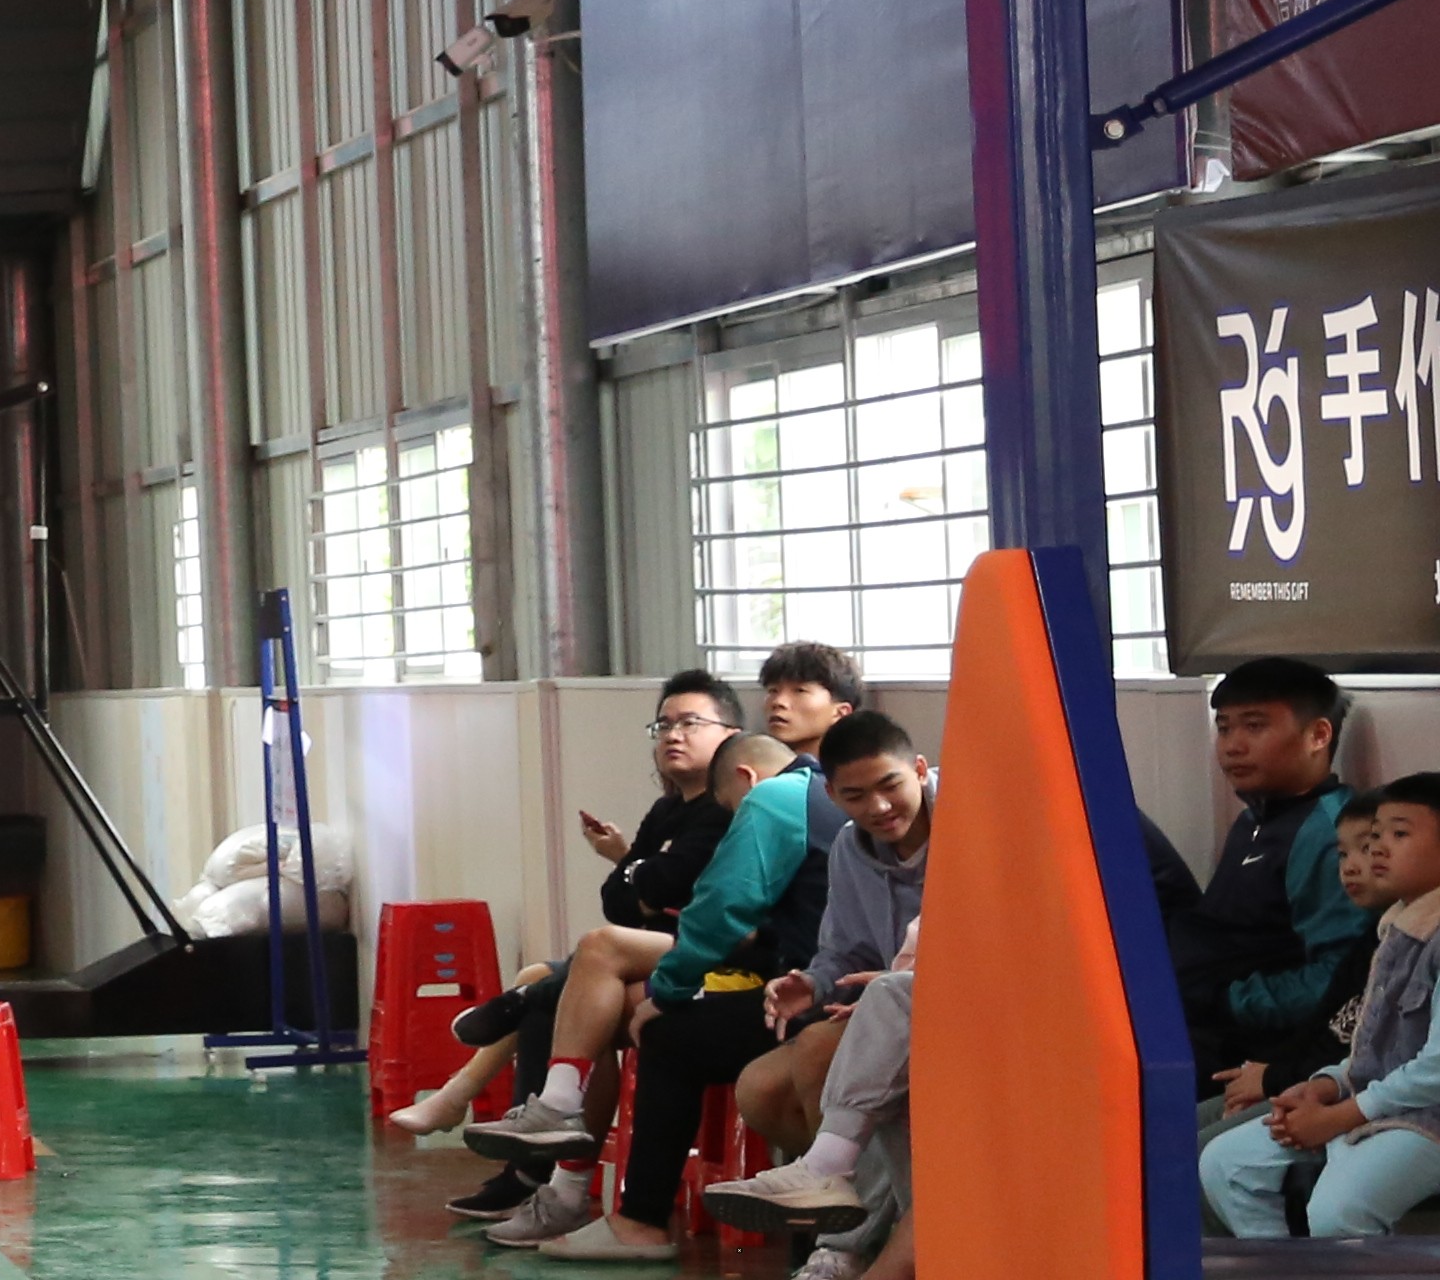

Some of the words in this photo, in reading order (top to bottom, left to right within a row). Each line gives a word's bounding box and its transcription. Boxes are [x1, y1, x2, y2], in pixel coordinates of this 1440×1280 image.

[1230, 582, 1272, 600] REMEMBER
[1273, 581, 1290, 600] THIS
[1291, 582, 1309, 600] GIFT
